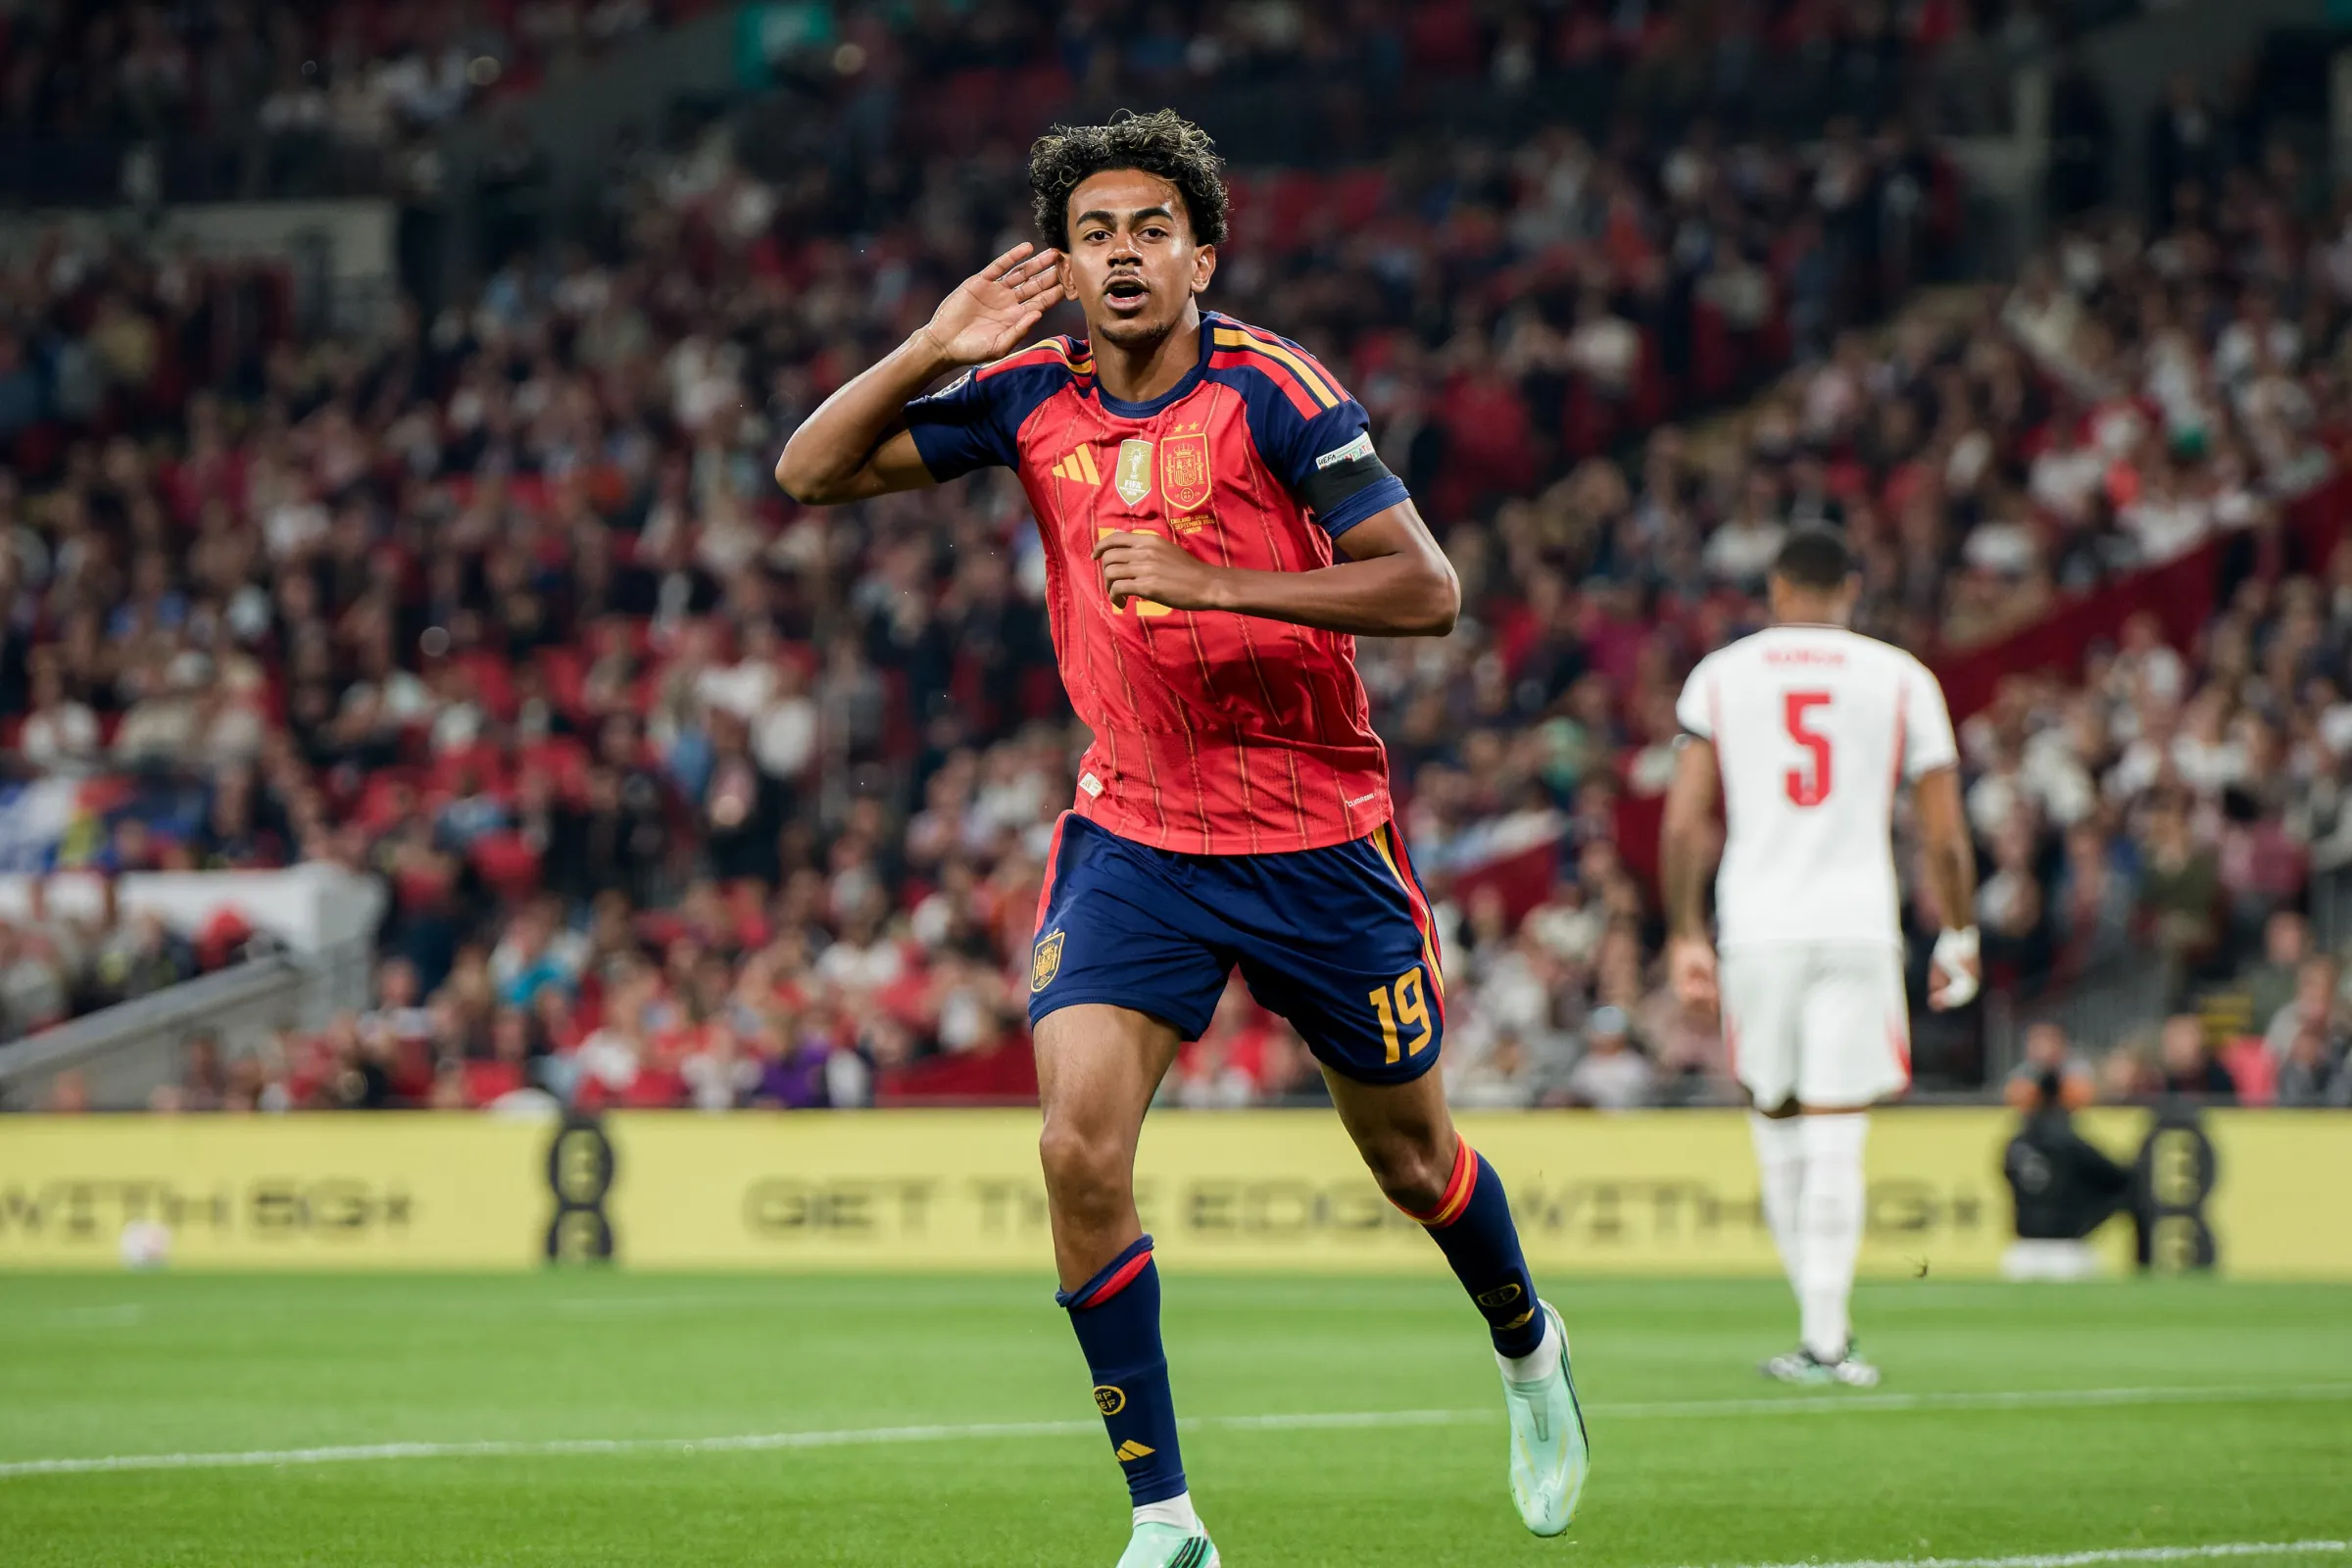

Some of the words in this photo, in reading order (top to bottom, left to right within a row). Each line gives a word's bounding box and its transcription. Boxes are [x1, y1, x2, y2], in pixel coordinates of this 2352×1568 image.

[1318, 454, 1337, 466] UEFA
[1124, 479, 1142, 490] FIFA
[1784, 691, 1832, 807] 5
[1369, 966, 1432, 1064] 19
[749, 1179, 938, 1238] GET
[1095, 1391, 1111, 1401] RF
[1099, 1398, 1115, 1409] EF
